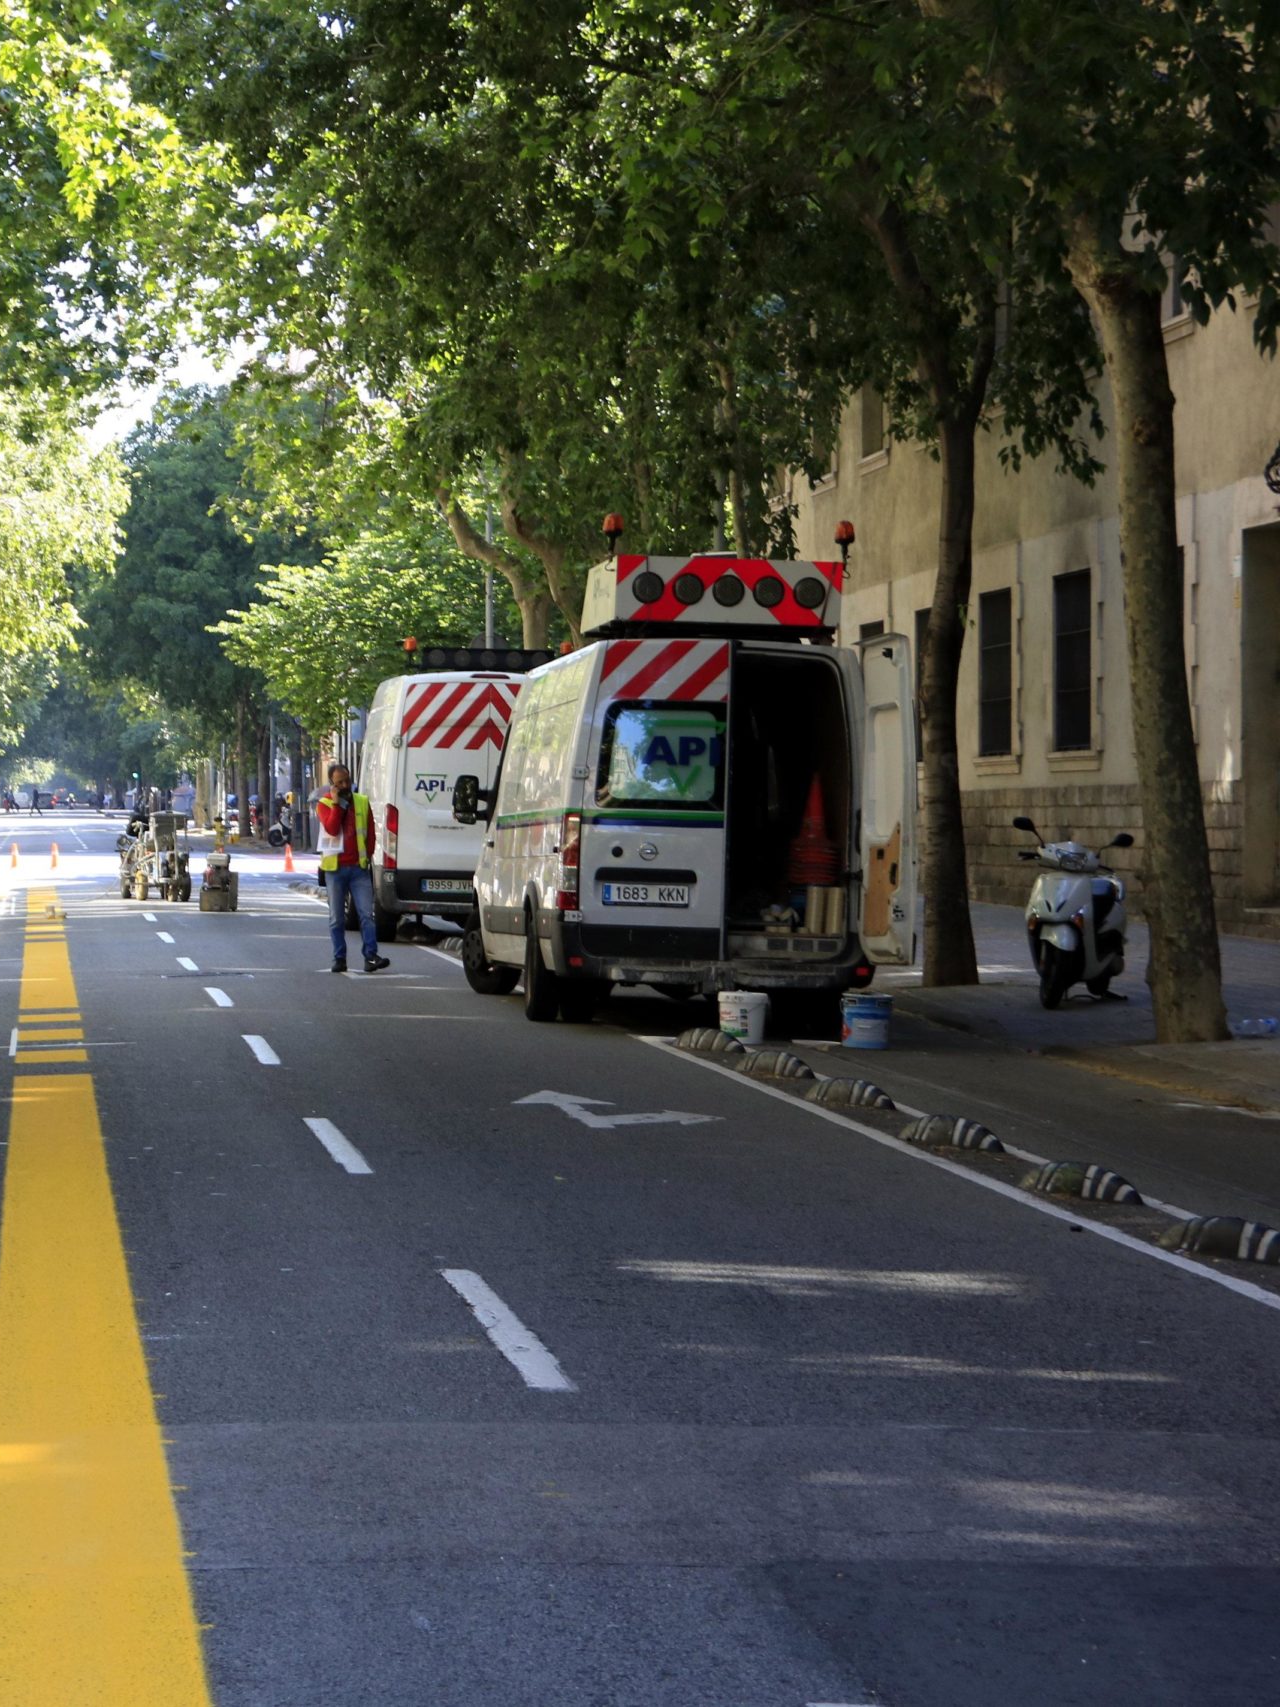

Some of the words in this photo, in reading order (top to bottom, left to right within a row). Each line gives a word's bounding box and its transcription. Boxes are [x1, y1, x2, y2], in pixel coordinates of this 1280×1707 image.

[642, 735, 721, 767] API
[415, 780, 445, 792] API
[428, 880, 453, 890] 9959
[616, 886, 649, 901] 1683
[658, 887, 685, 902] KKN
